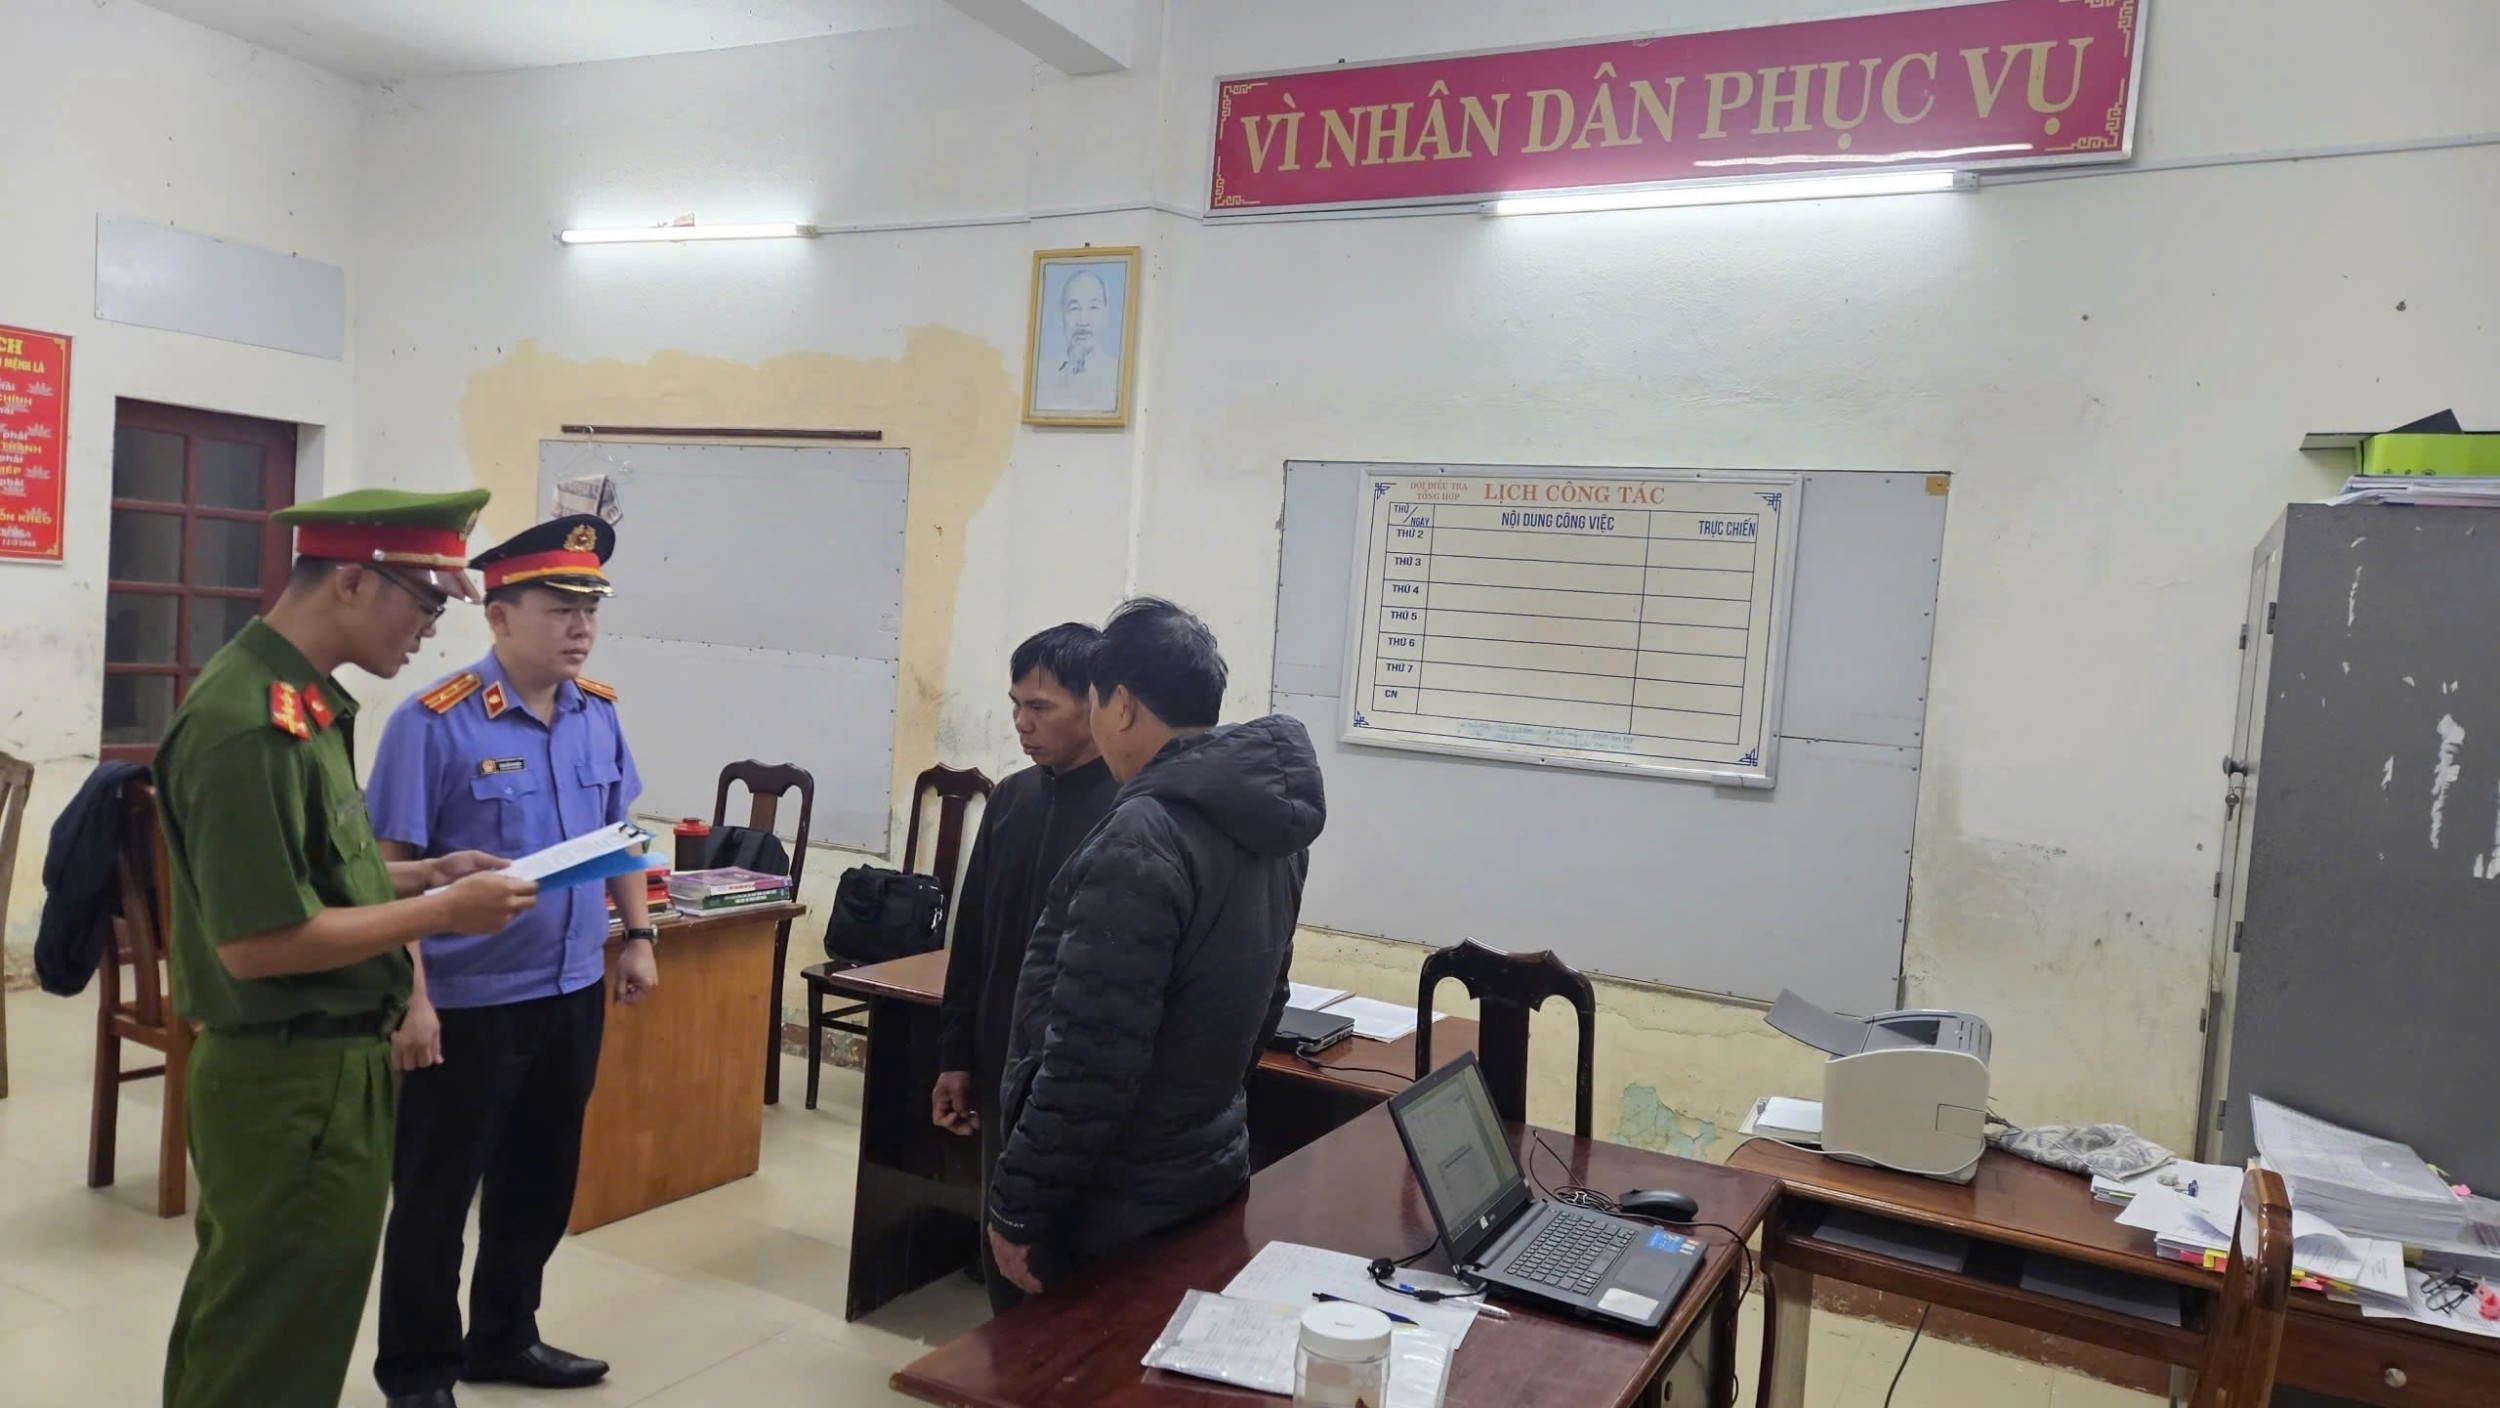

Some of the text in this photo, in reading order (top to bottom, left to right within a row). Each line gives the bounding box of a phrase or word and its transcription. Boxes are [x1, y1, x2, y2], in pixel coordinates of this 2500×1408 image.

[1240, 37, 2094, 174] VÌ NHÂN DÂN PHỤC VỤ
[1484, 481, 1665, 504] LỊCH CÔNG TÁC
[1501, 510, 1615, 533] NỘI DUNG CÔNG VIỆC
[1397, 528, 1424, 539] THỨ 2
[1699, 517, 1756, 539] TRỰC CHIẾN
[1394, 556, 1422, 567] THỨ 3
[1392, 583, 1419, 594] THỨ 4
[1390, 610, 1417, 621] THỨ 5
[1388, 637, 1415, 647] THỨ 6
[1386, 662, 1413, 673] THỨ 7
[1385, 690, 1398, 699] CN
